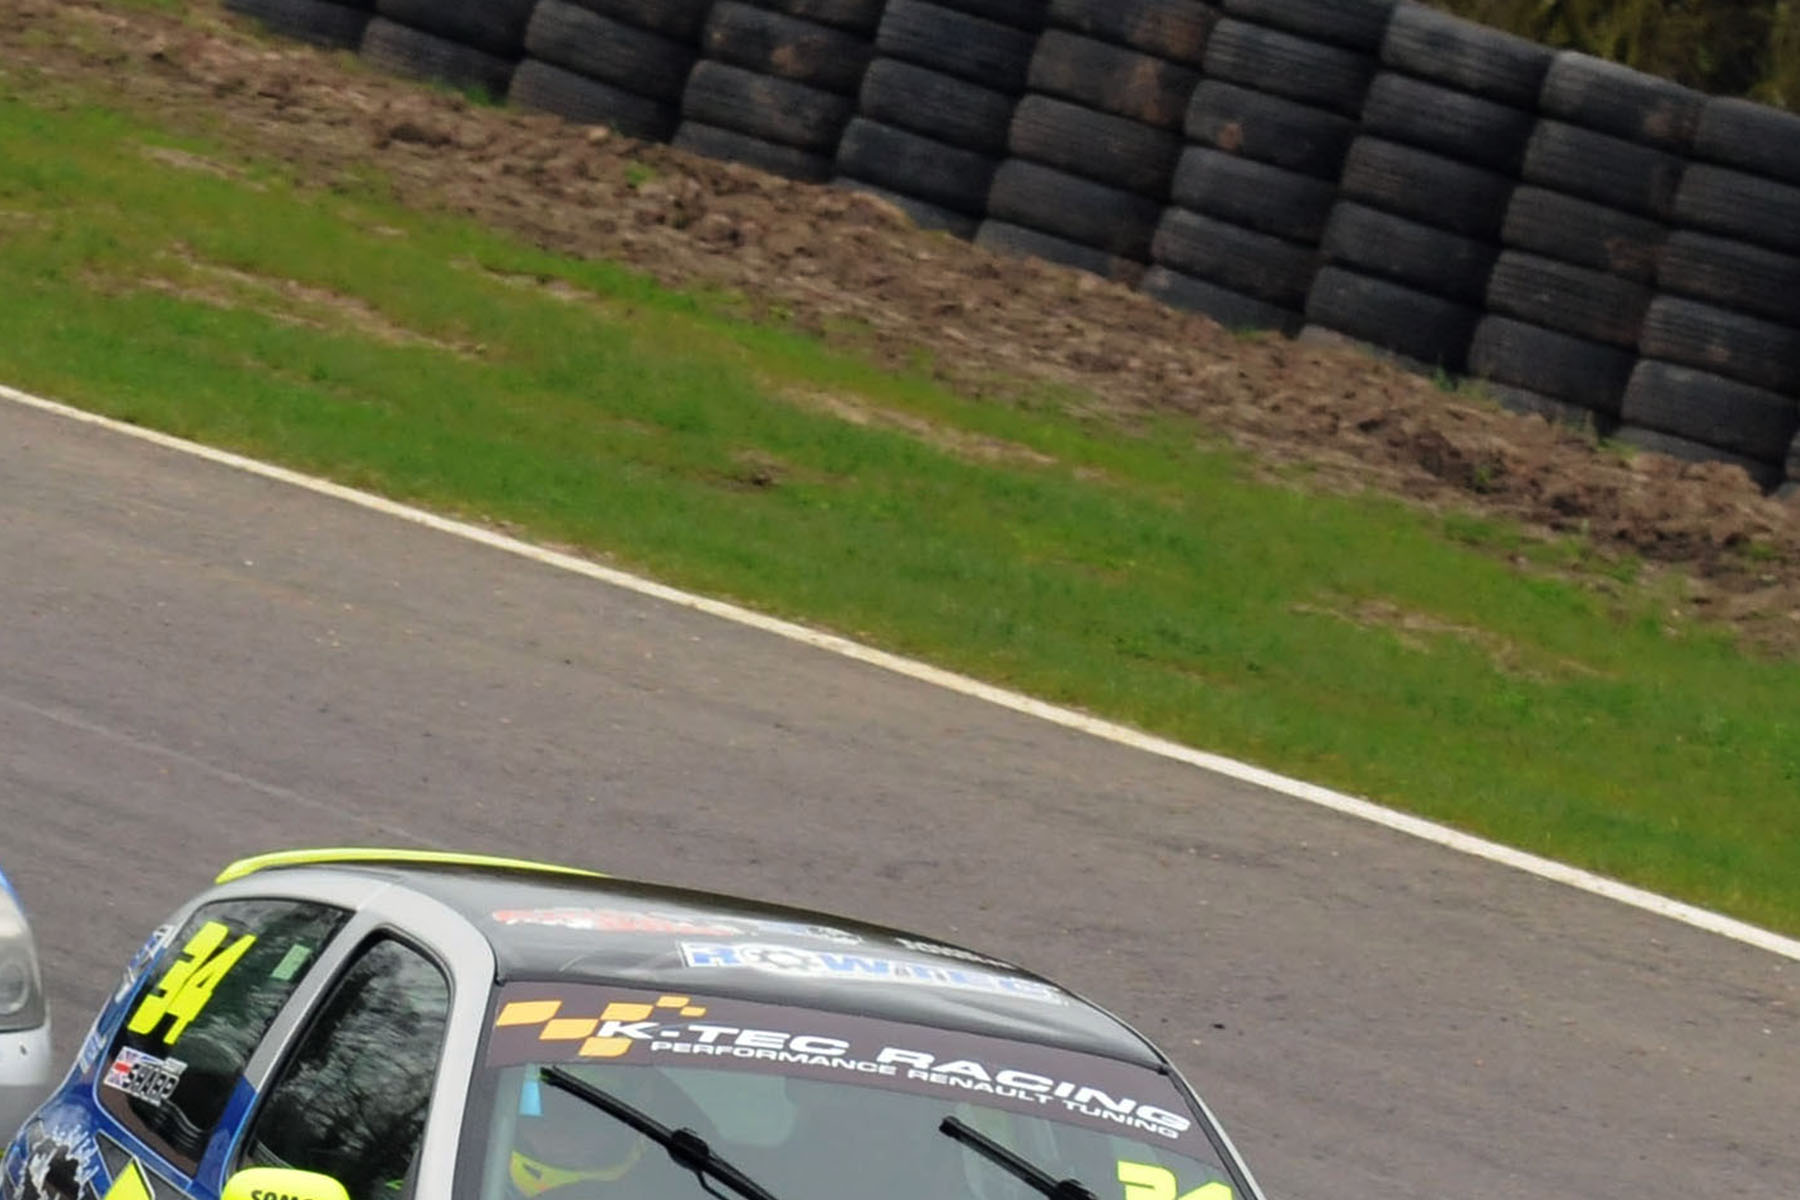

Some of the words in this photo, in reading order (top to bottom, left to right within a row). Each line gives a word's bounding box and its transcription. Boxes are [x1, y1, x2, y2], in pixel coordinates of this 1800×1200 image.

[126, 921, 256, 1045] 34
[597, 1020, 850, 1057] K-TEC
[876, 1047, 1191, 1133] RACING
[651, 1040, 896, 1076] PERFORMANCE
[907, 1070, 1054, 1104] RENAULT
[1065, 1102, 1180, 1139] TUNING
